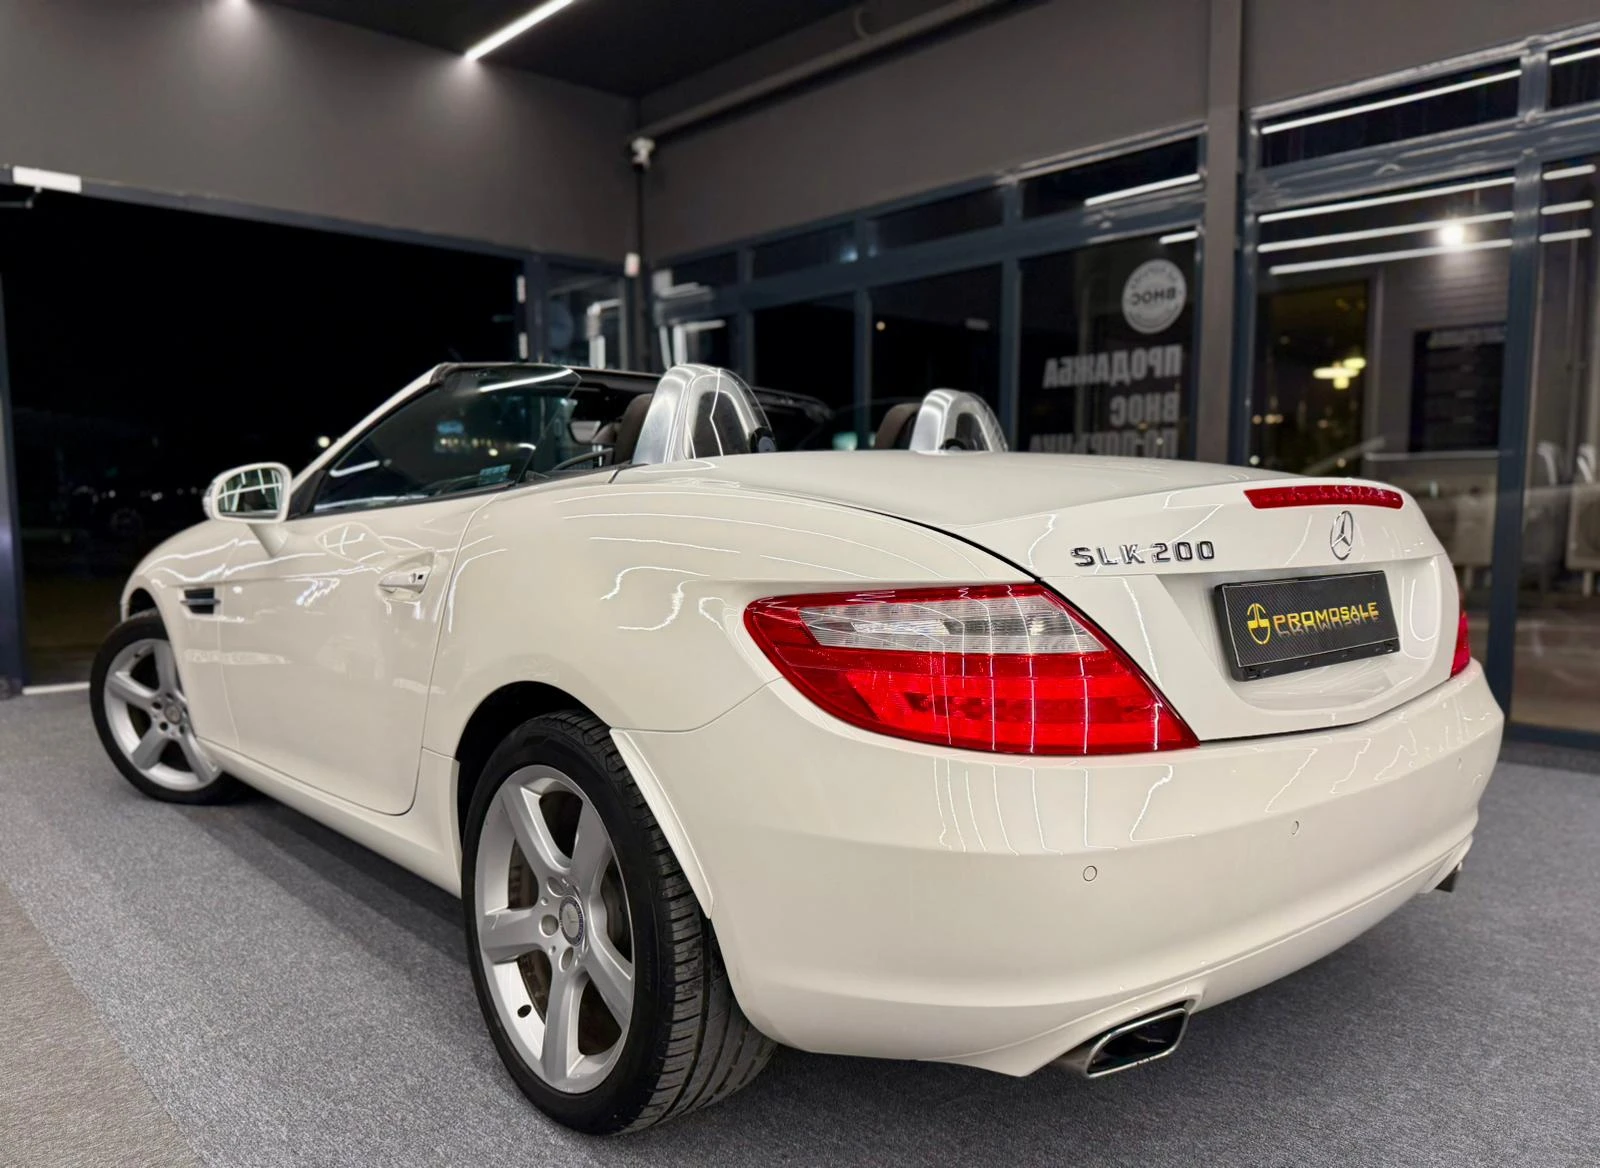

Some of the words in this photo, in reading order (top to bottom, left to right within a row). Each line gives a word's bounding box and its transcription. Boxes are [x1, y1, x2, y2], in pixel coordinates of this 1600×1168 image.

[1071, 544, 1145, 567] SLK
[1151, 540, 1215, 563] 200
[1272, 602, 1380, 631] PROMOSALE
